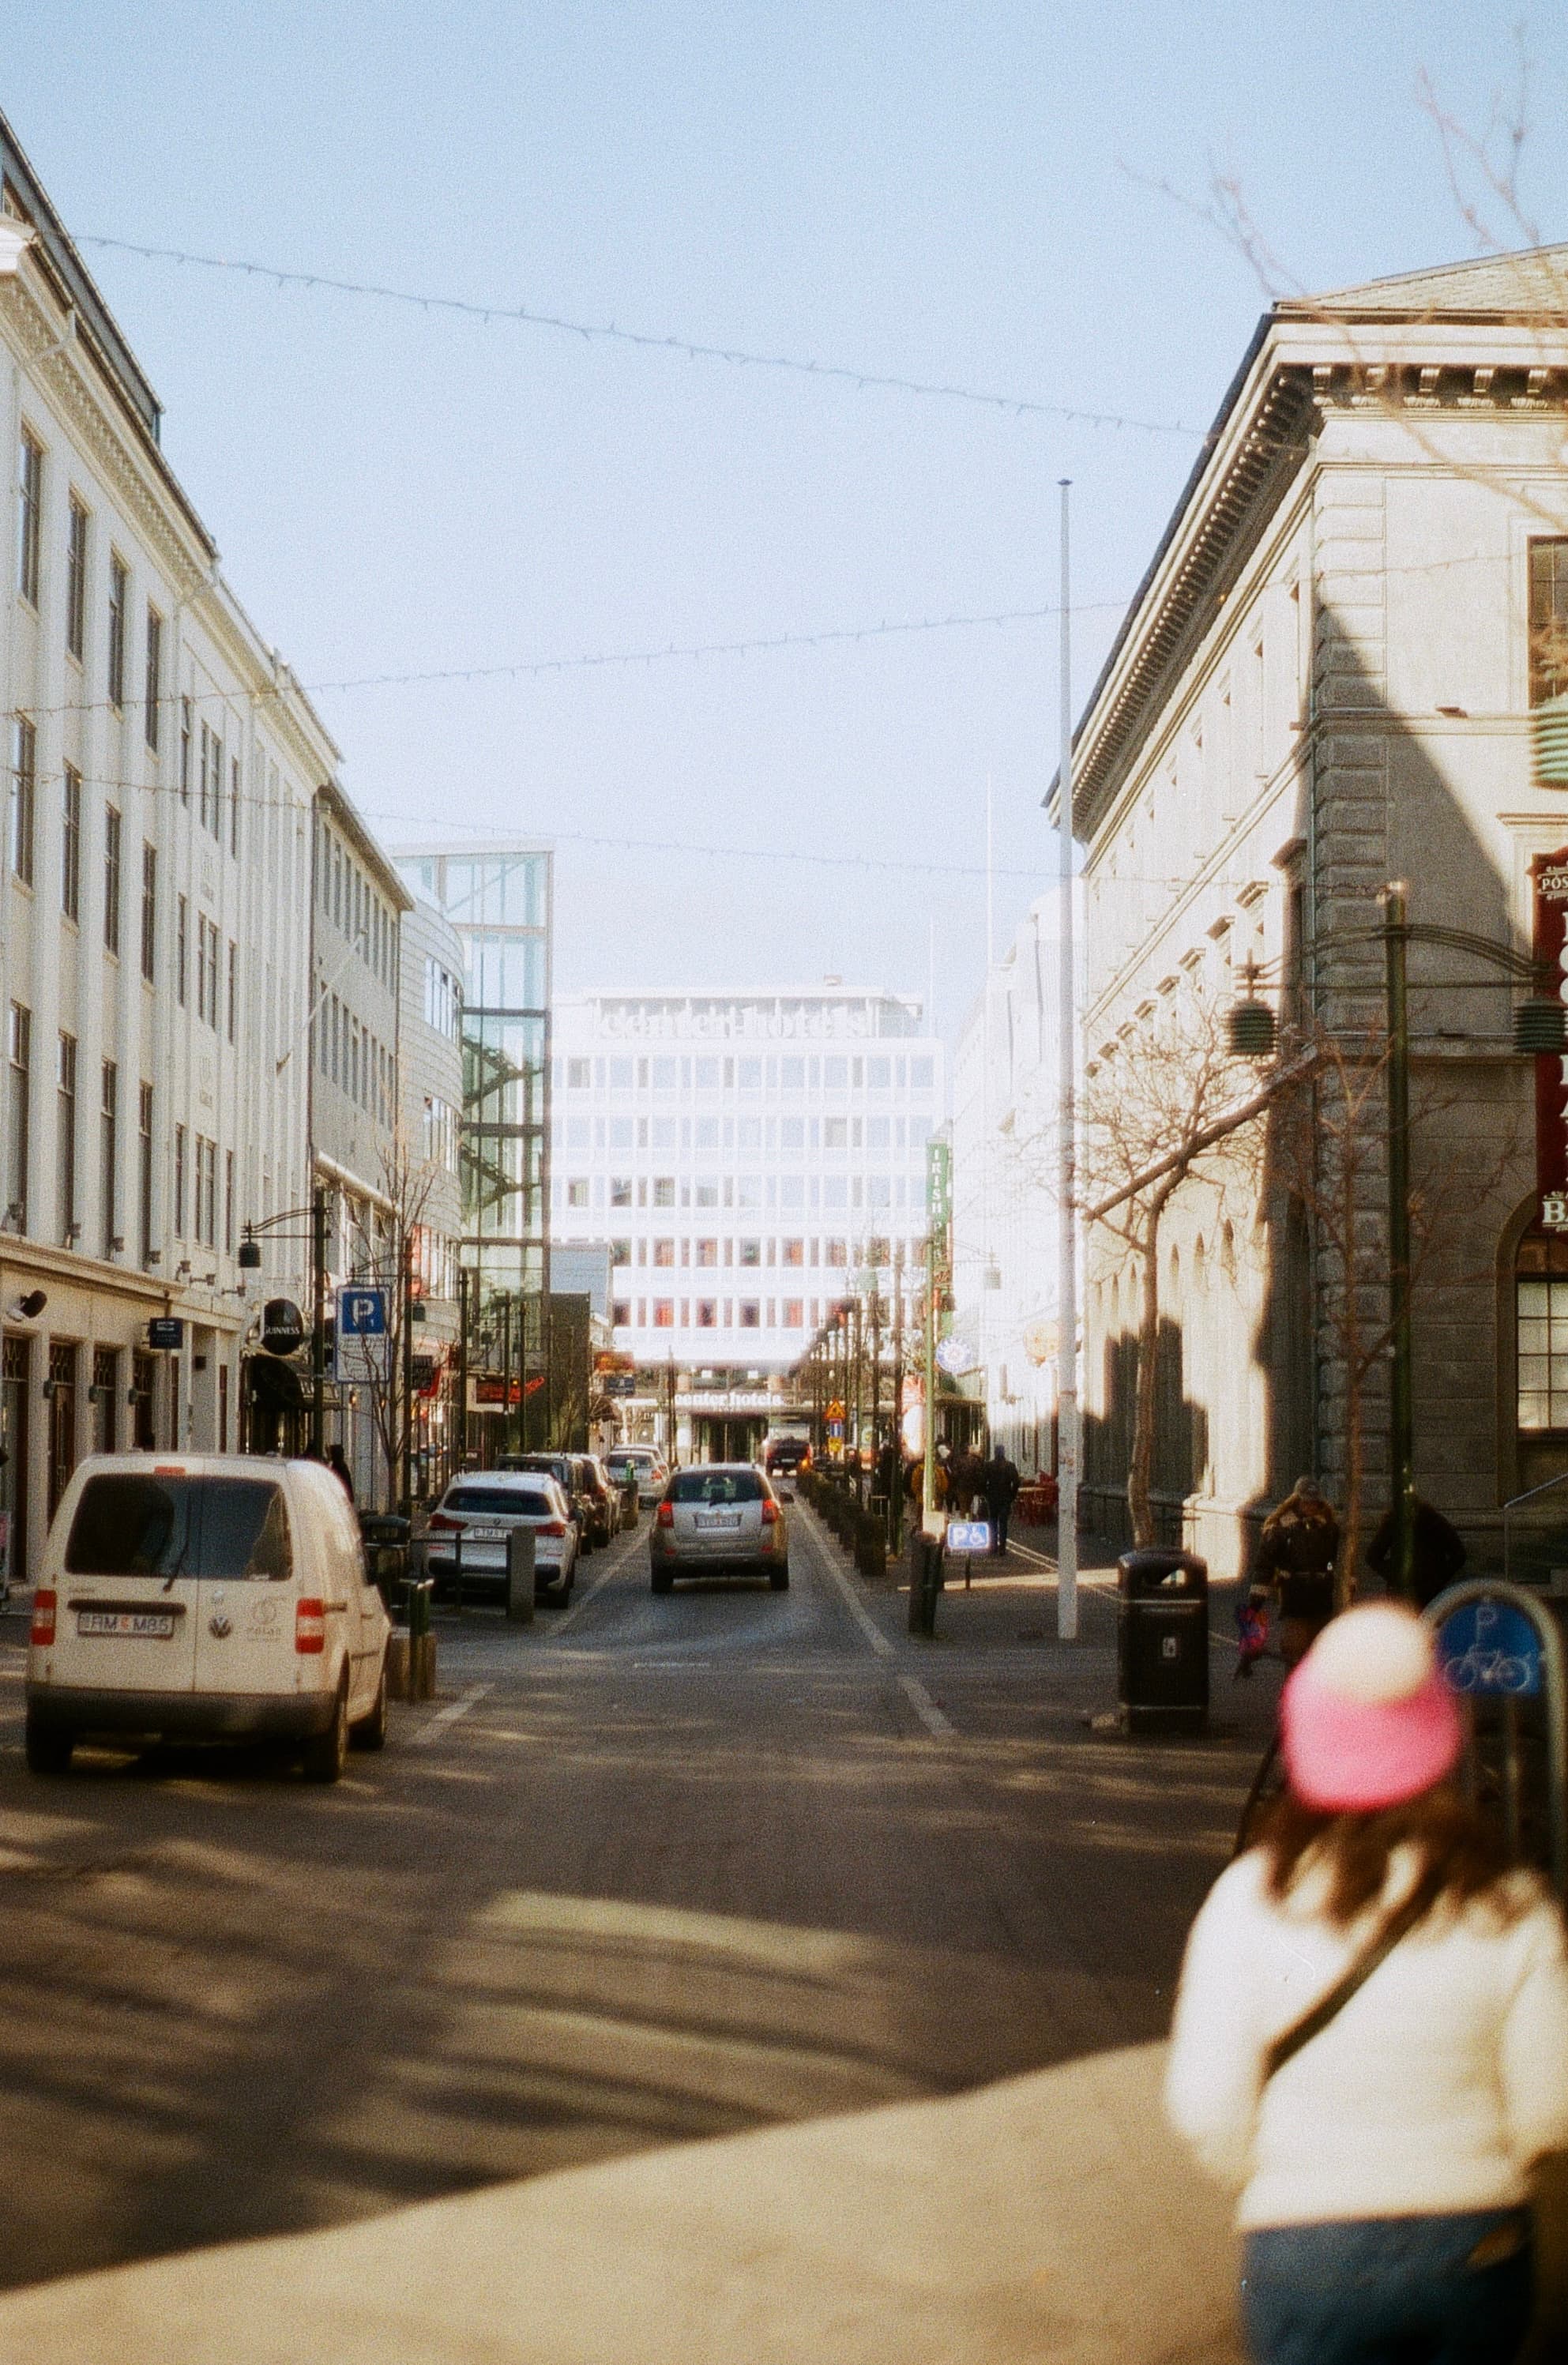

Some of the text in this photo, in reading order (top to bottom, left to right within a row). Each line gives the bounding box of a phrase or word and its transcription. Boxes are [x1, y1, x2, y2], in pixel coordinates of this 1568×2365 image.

[931, 1149, 942, 1213] IRISH
[353, 1299, 375, 1327] P
[953, 1526, 968, 1546] P
